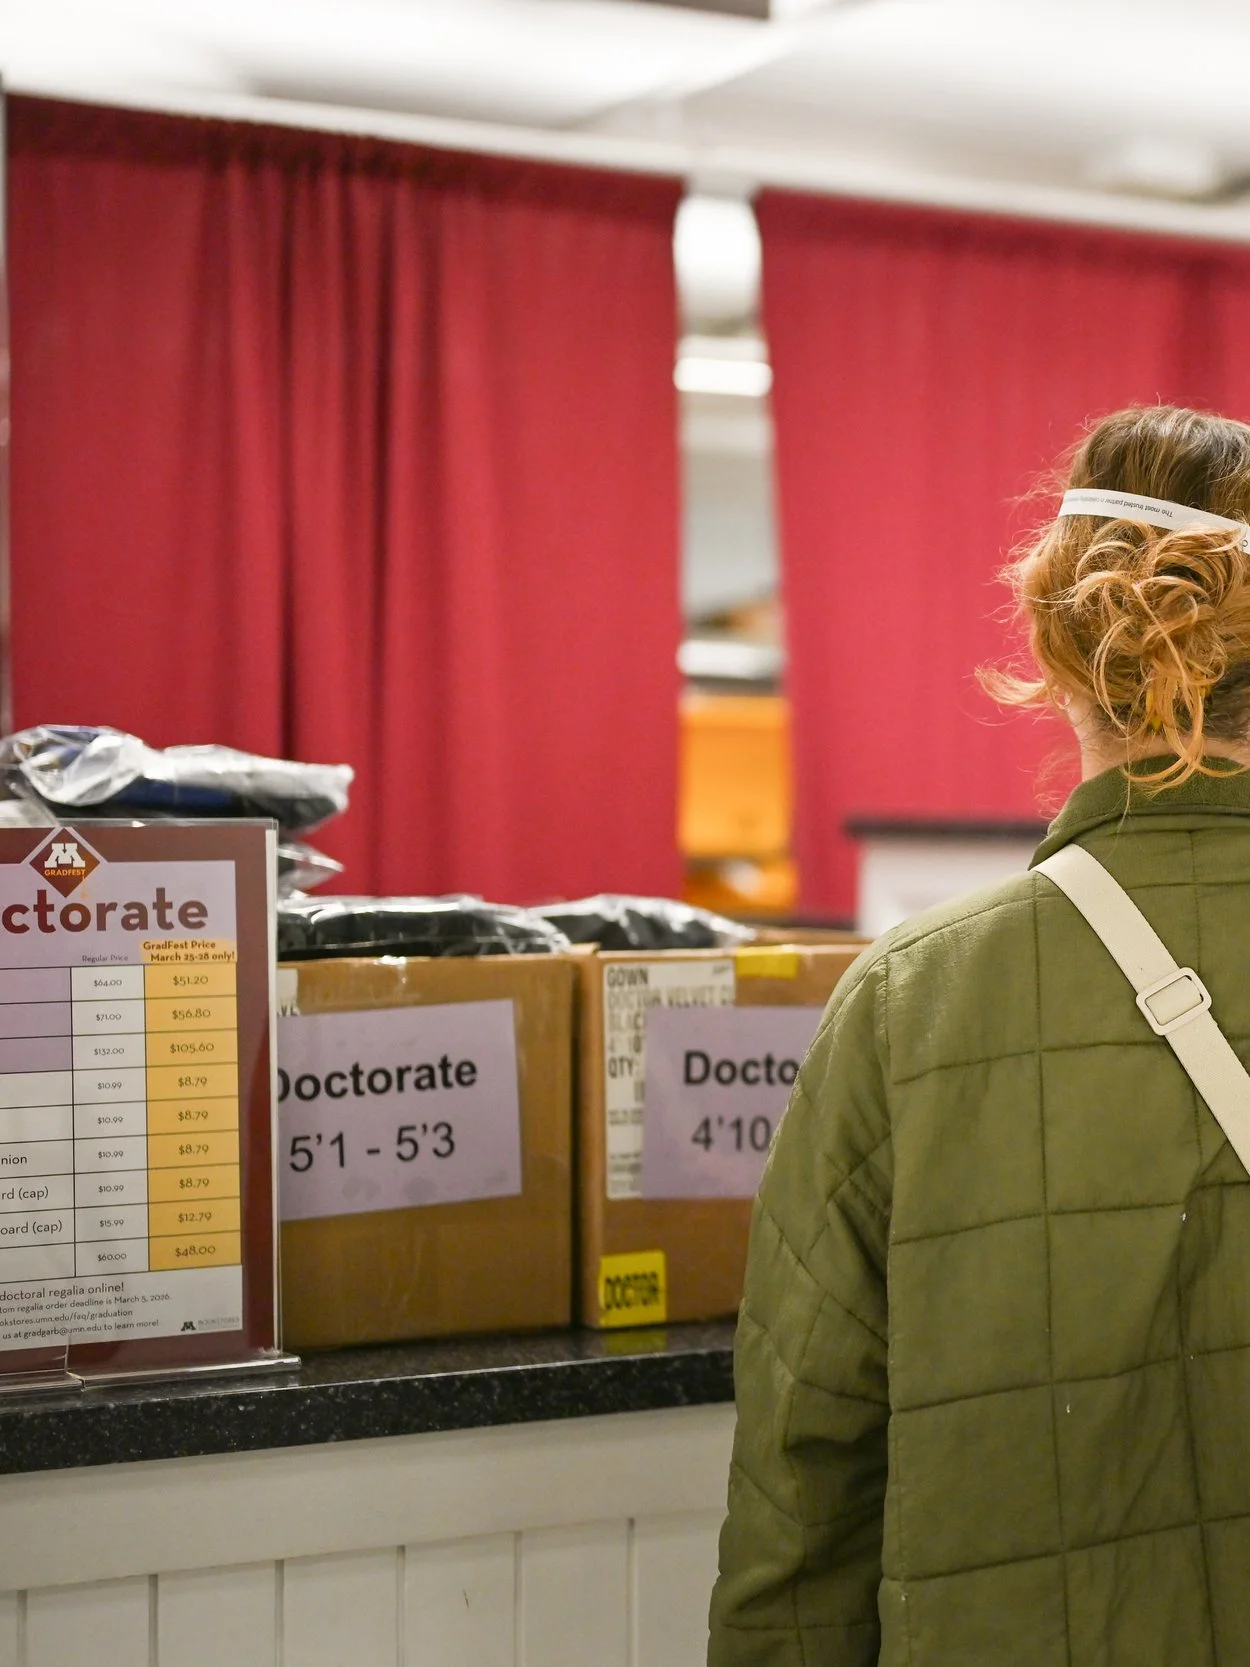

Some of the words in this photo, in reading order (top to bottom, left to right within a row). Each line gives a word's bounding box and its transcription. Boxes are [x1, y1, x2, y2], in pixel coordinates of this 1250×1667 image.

[1123, 501, 1144, 510] trusted
[44, 869, 86, 877] GRADFEST
[143, 940, 188, 951] GradFest
[191, 940, 216, 950] Price
[82, 954, 108, 963] Regular
[110, 953, 129, 962] Price
[150, 951, 181, 962] March
[212, 951, 235, 964] only!
[93, 979, 123, 987] $64.00
[172, 975, 209, 986] $51.20
[606, 967, 649, 988] GOWN
[95, 1013, 122, 1021] $71.00
[172, 1008, 211, 1020] $56.80
[94, 1047, 125, 1055] $132.00
[170, 1042, 214, 1054] $105.60
[97, 1082, 122, 1090] $10.99
[177, 1076, 208, 1087] $8.79
[97, 1116, 123, 1124] $10.99
[177, 1110, 208, 1122] $8.79
[178, 1144, 209, 1155] $8.79
[289, 1131, 346, 1173] 5'1
[396, 1121, 456, 1163] 5'3
[98, 1151, 124, 1159] $10.99
[98, 1184, 124, 1193] $10.99
[179, 1178, 210, 1189] $8.79
[18, 1185, 49, 1201] (cap)
[99, 1219, 125, 1227] $15.99
[177, 1212, 212, 1223] $12.79
[32, 1219, 63, 1235] (cap)
[175, 1245, 216, 1257] $48.00
[97, 1253, 127, 1261] $60.00
[0, 1287, 46, 1301] doctoral
[48, 1284, 85, 1299] regalia
[87, 1281, 125, 1294] online!
[17, 1303, 43, 1313] regalia
[45, 1301, 67, 1310] order
[70, 1298, 104, 1308] deadline
[106, 1297, 112, 1305] is
[114, 1295, 140, 1304] March
[104, 1323, 113, 1331] to
[114, 1320, 135, 1330] learn
[136, 1319, 159, 1328] more!
